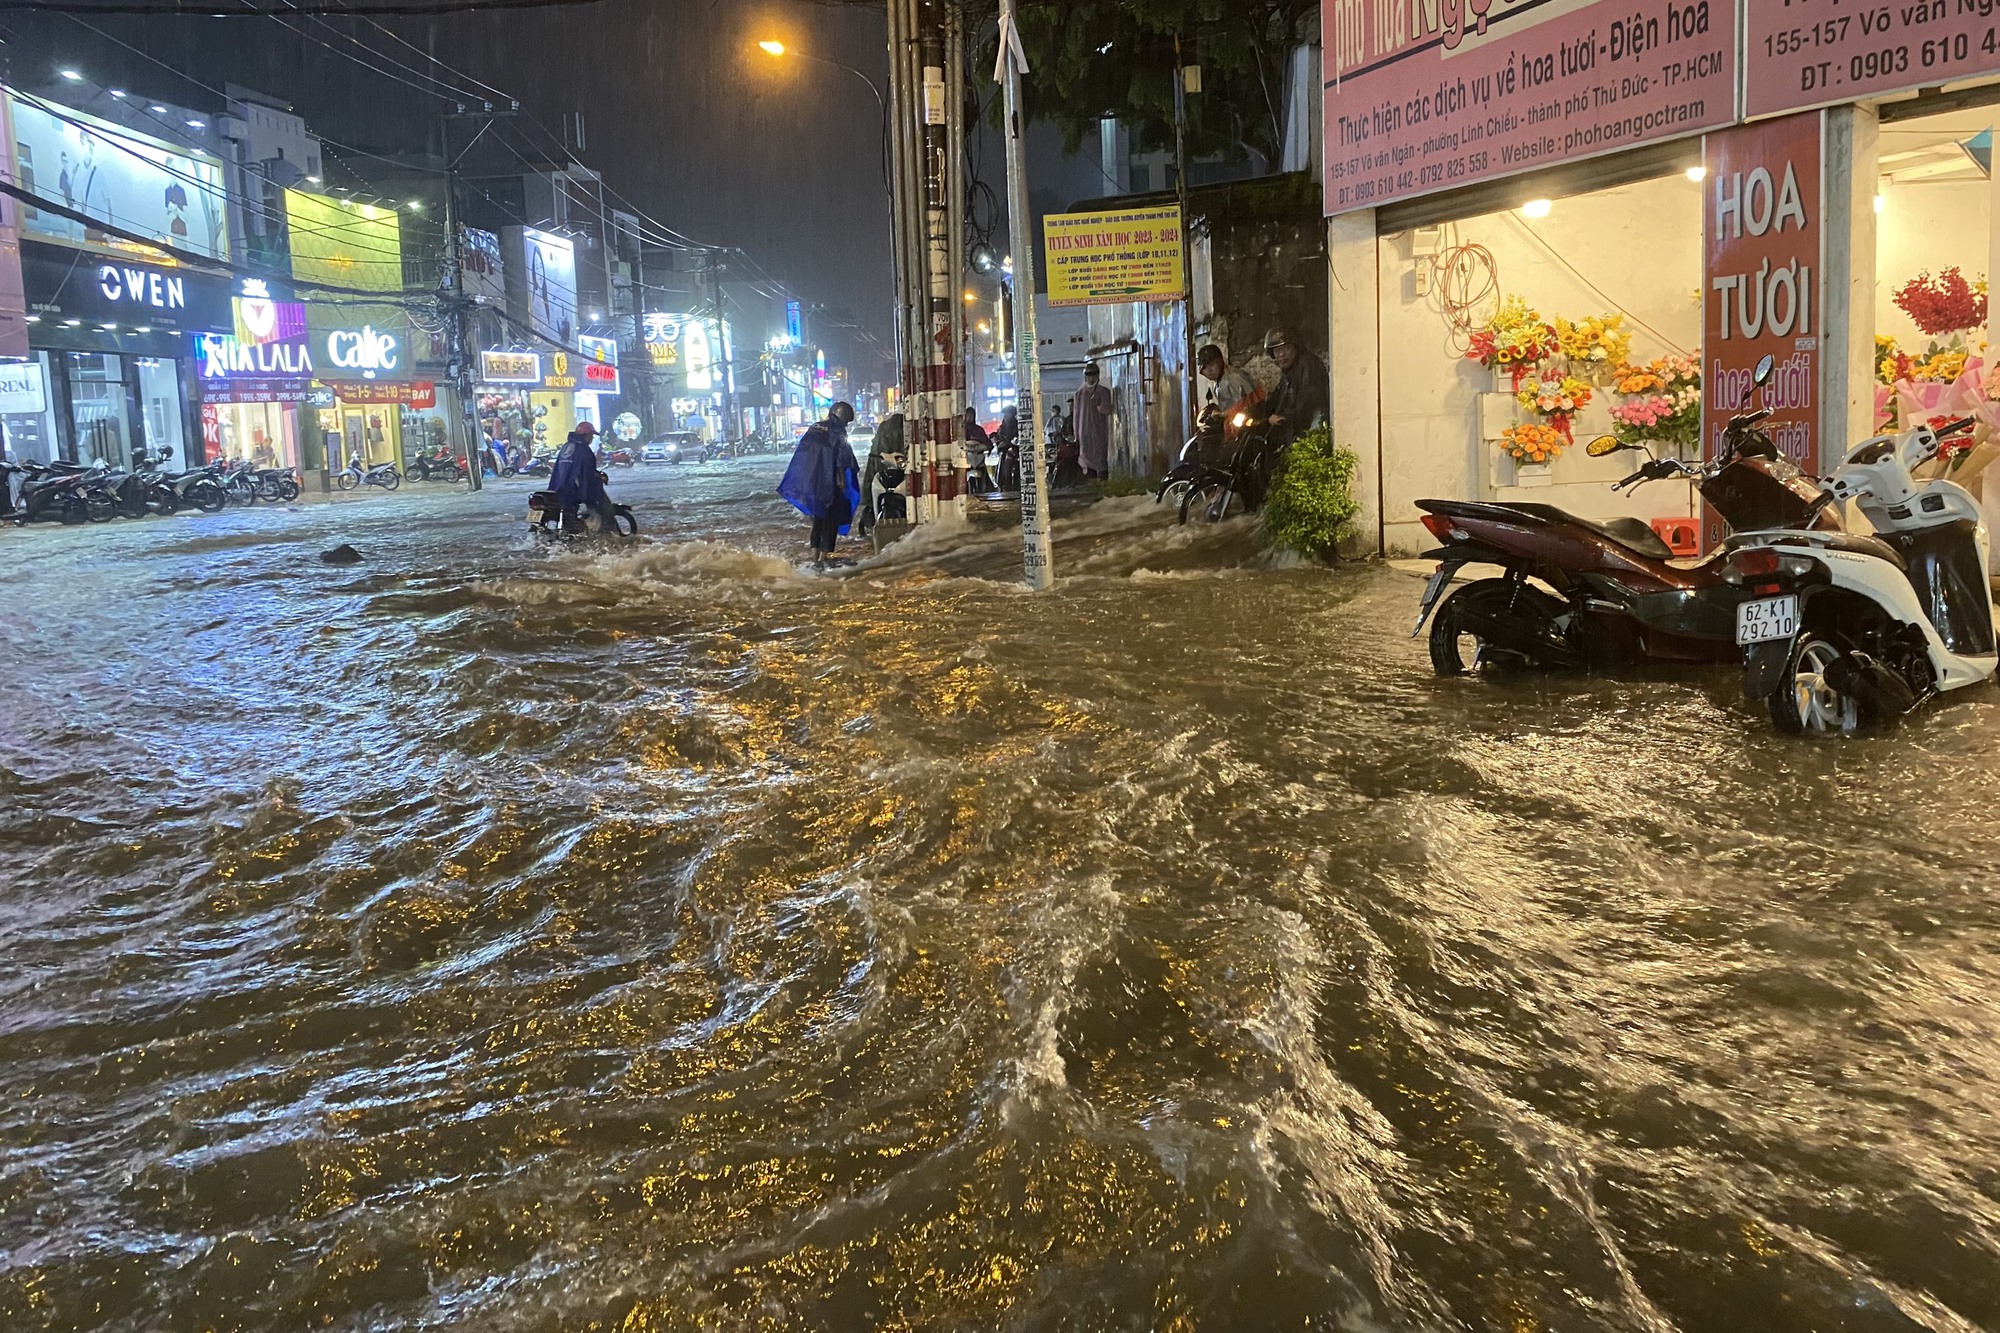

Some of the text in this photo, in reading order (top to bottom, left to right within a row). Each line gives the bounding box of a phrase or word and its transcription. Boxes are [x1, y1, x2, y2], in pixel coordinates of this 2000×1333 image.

[1764, 16, 1851, 58] 155-157
[1859, 7, 1891, 36] Võ
[1850, 46, 1909, 81] 0903
[1921, 33, 1968, 67] 610
[1338, 1, 1709, 149] Thực hiện các dịch vụ về hoa tươi Điện hoa
[1331, 158, 1359, 180] 155-157
[1361, 153, 1373, 171] Võ
[1391, 143, 1415, 166] Ngân
[1461, 122, 1484, 145] Linh
[1528, 98, 1561, 125] thành
[1564, 86, 1589, 120] phố
[1592, 79, 1617, 108] Thủ
[1621, 73, 1649, 100] Đức
[1662, 50, 1723, 88] TP.HCM
[1355, 180, 1375, 201] 0903
[1377, 175, 1394, 196] 610
[1396, 170, 1413, 190] 442
[1420, 162, 1443, 185] 0792
[1447, 155, 1465, 178] 825
[1469, 150, 1488, 173] 558
[1564, 99, 1705, 155] phohoangoctram
[1715, 159, 1807, 240] HOA
[1069, 255, 1089, 264] TRUNG
[1074, 234, 1093, 249] SINH
[1114, 230, 1131, 249] HỌC
[1133, 229, 1153, 245] 2023
[1160, 227, 1179, 243] 2024
[98, 265, 185, 309] OWEN
[1713, 255, 1810, 340] TƯƠI
[1714, 358, 1752, 411] hoa
[1740, 617, 1792, 641] 292.10
[1746, 599, 1786, 622] 62-K1
